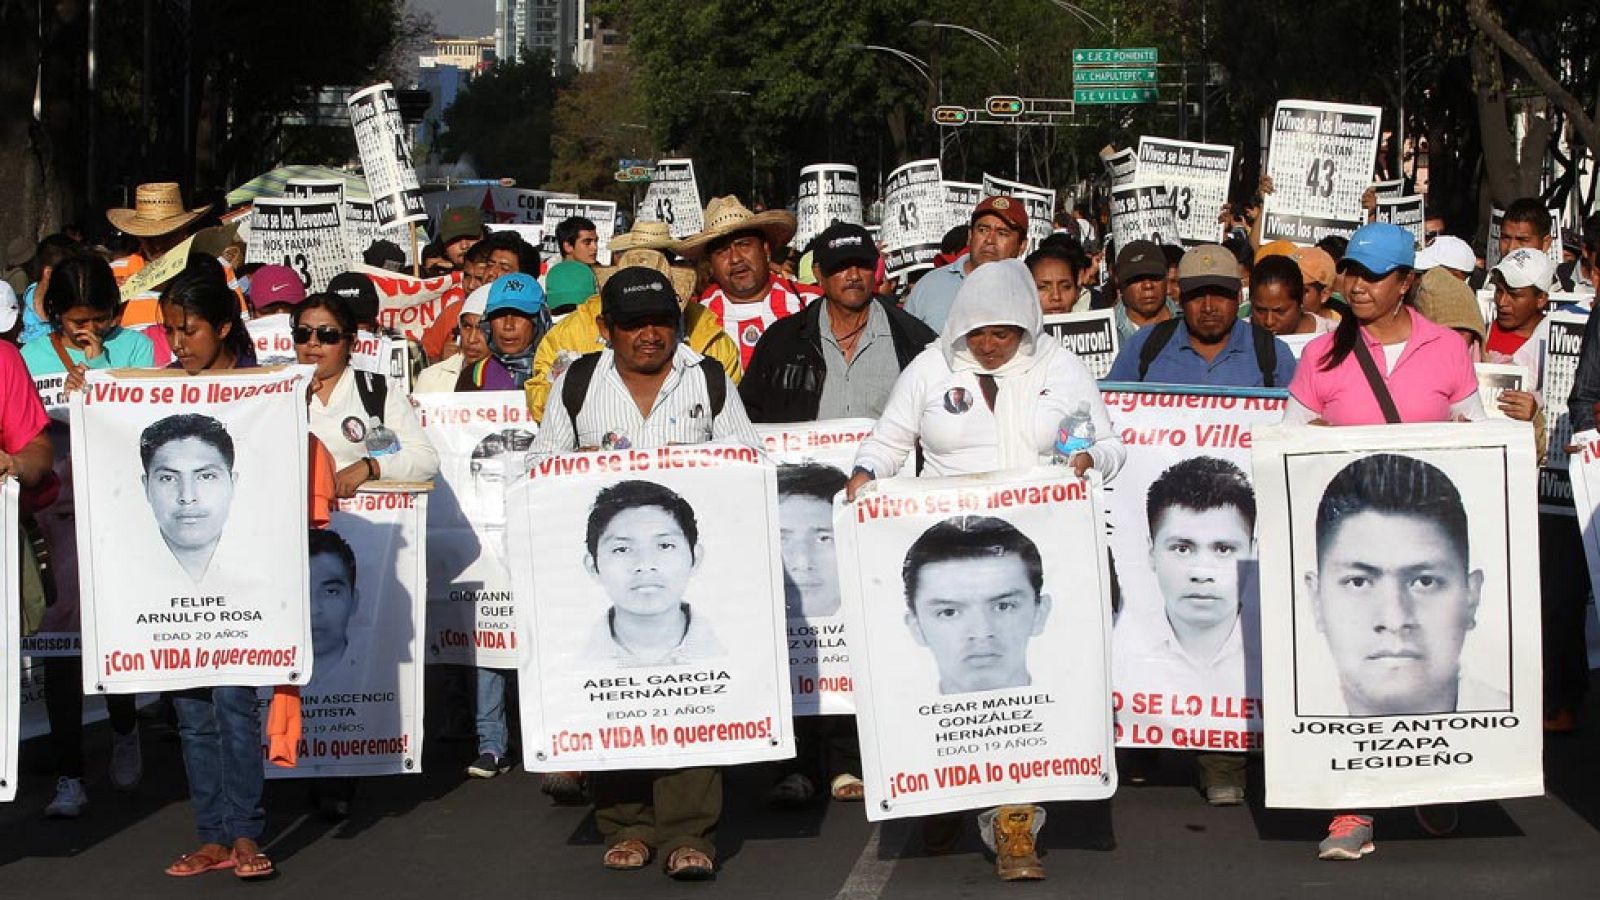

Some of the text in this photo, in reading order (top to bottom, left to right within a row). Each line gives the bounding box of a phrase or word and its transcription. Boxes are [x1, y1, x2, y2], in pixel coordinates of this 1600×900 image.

[1088, 52, 1104, 61] EJE
[1090, 71, 1142, 81] CHAPULTEPEC
[1079, 91, 1139, 101] SEVILLA
[1306, 116, 1318, 132] se
[1319, 112, 1333, 135] los
[1306, 158, 1336, 199] 43
[280, 206, 295, 230] los
[899, 201, 920, 231] 43
[1297, 219, 1312, 239] los
[285, 237, 321, 250] FALTAN
[84, 381, 145, 406] ¡Vivo
[149, 385, 174, 405] se
[180, 382, 201, 404] lo
[475, 408, 498, 424] se
[503, 404, 520, 423] lo
[529, 447, 759, 480] ¡Vivo se lo llevaron!
[857, 480, 1087, 524] ¡Vivo se lo llevaron!
[170, 595, 227, 608] FELIPE
[136, 610, 263, 625] ARNULFO ROSA
[152, 628, 249, 642] EDAD 20 AÑOS
[472, 631, 507, 650] VIDA
[803, 638, 847, 649] VILLA
[104, 644, 298, 676] ¡Con VIDA lo queremos!
[583, 669, 732, 690] ABEL GARCÍA
[798, 674, 814, 695] lo
[590, 683, 728, 702] HERNÁNDEZ
[606, 704, 716, 721] EDAD 21 AÑOS
[918, 693, 1056, 716] CÉSAR MANUEL
[1132, 692, 1163, 715] SE
[1171, 694, 1204, 717] LO
[313, 723, 365, 734] 19 AÑOS
[938, 709, 1034, 729] GONZÁLEZ
[1291, 715, 1520, 735] JORGE ANTONIO
[551, 716, 773, 757] ¡Con VIDA lo queremos!
[934, 722, 1045, 744] HERNÁNDEZ
[1132, 723, 1164, 744] LO
[313, 734, 408, 761] lo queremos!
[936, 736, 1048, 757] EDAD 19 AÑOS
[1352, 736, 1450, 753] TIZAPA
[1331, 751, 1474, 772] LEGIDEÑO
[889, 753, 1103, 798] ¡Con VIDA lo queremos!
